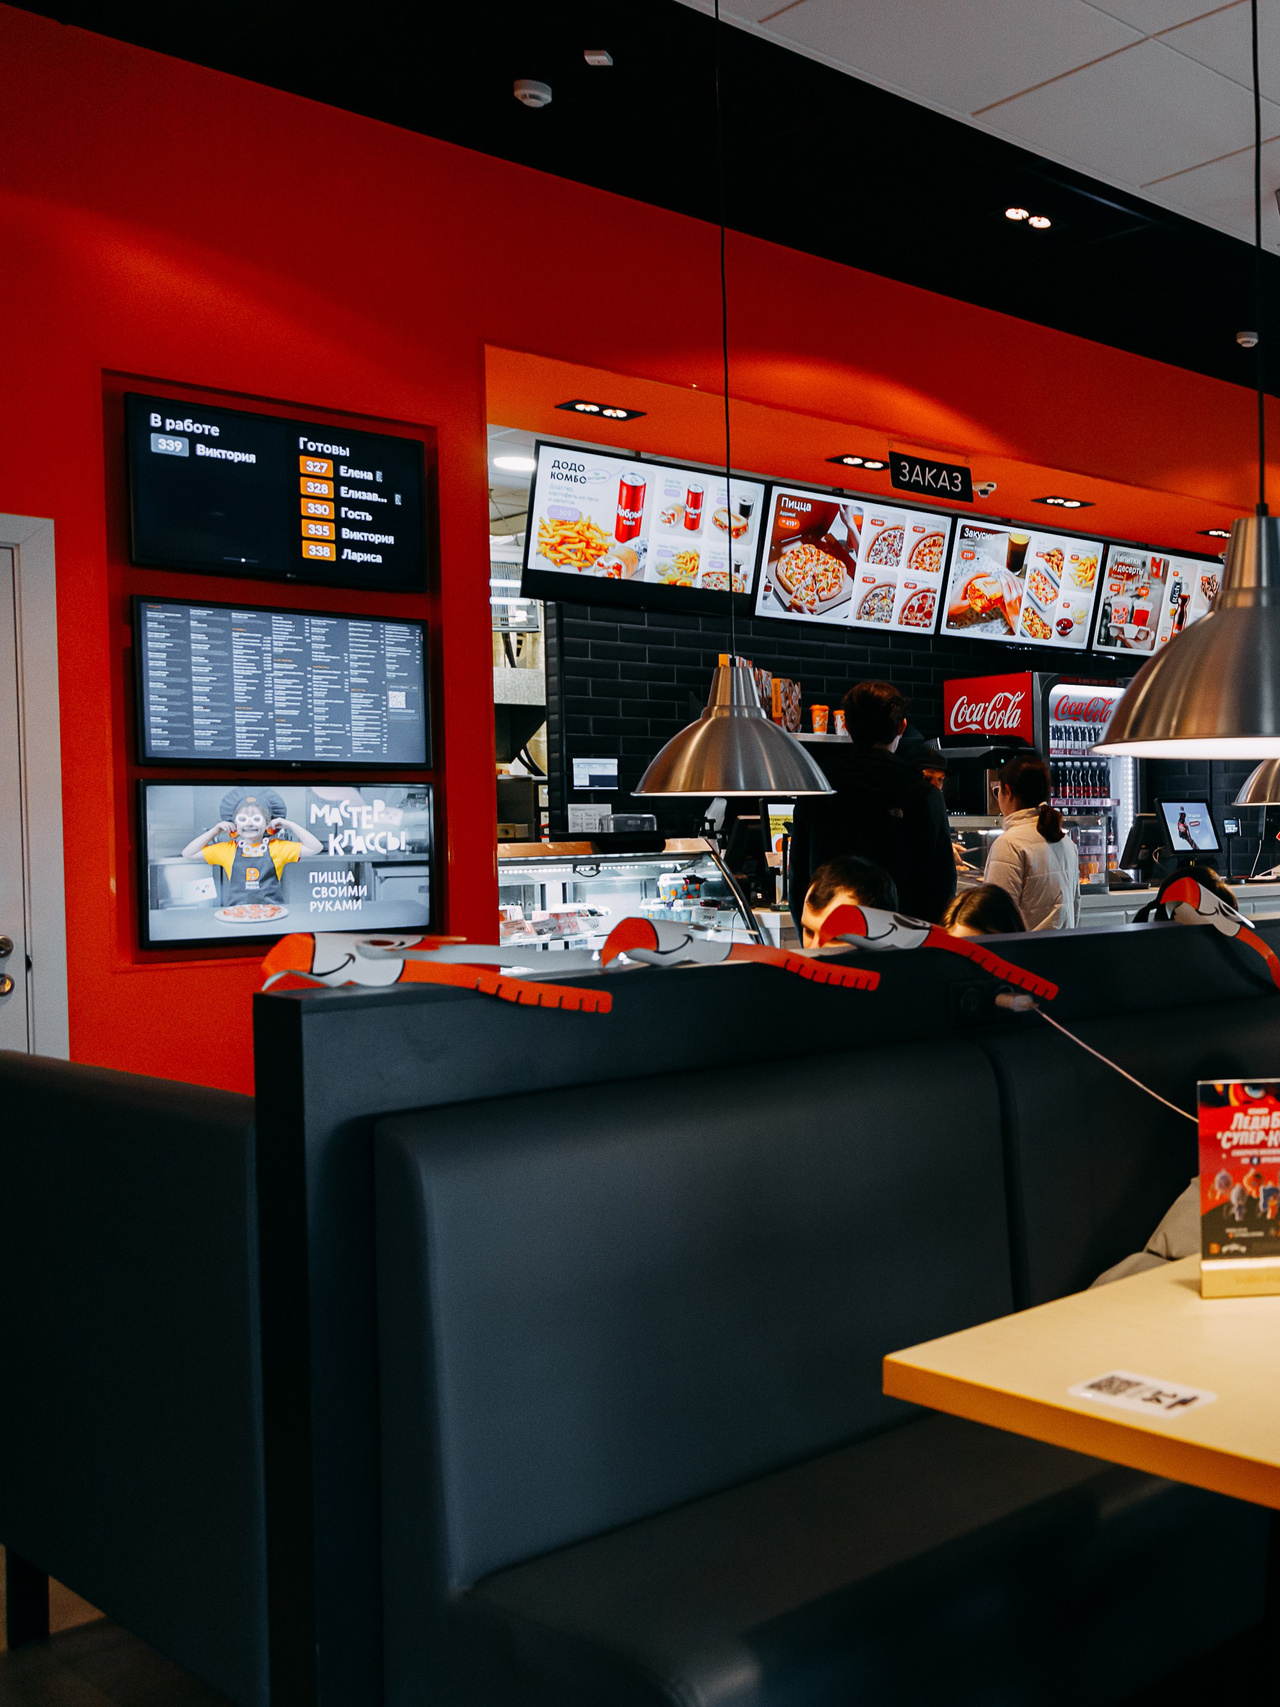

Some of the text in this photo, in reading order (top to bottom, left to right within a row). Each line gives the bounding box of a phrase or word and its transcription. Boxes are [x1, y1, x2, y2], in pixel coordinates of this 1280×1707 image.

[150, 413, 220, 436] В работе
[158, 438, 256, 463] 339 Виктория
[299, 437, 350, 457] Готовы
[306, 460, 374, 481] 327 Елена
[551, 460, 586, 472] ДОДО
[550, 471, 587, 484] КОМБО
[899, 461, 962, 492] ЗАКАЗ
[306, 482, 329, 494] 328
[307, 503, 373, 521] 330 Гость
[781, 497, 812, 512] Пицца
[308, 524, 395, 544] 335 Виктория
[964, 527, 995, 541] Закуски
[308, 545, 383, 563] 338 Лариса
[950, 691, 1026, 732] Coca-Cola
[1054, 695, 1116, 723] Coca-Cola
[328, 829, 406, 857] КЛАССЫ
[309, 871, 355, 884] ПИЦЦА
[312, 885, 367, 899] СВОИМИ
[309, 899, 363, 913] РУКАМИ
